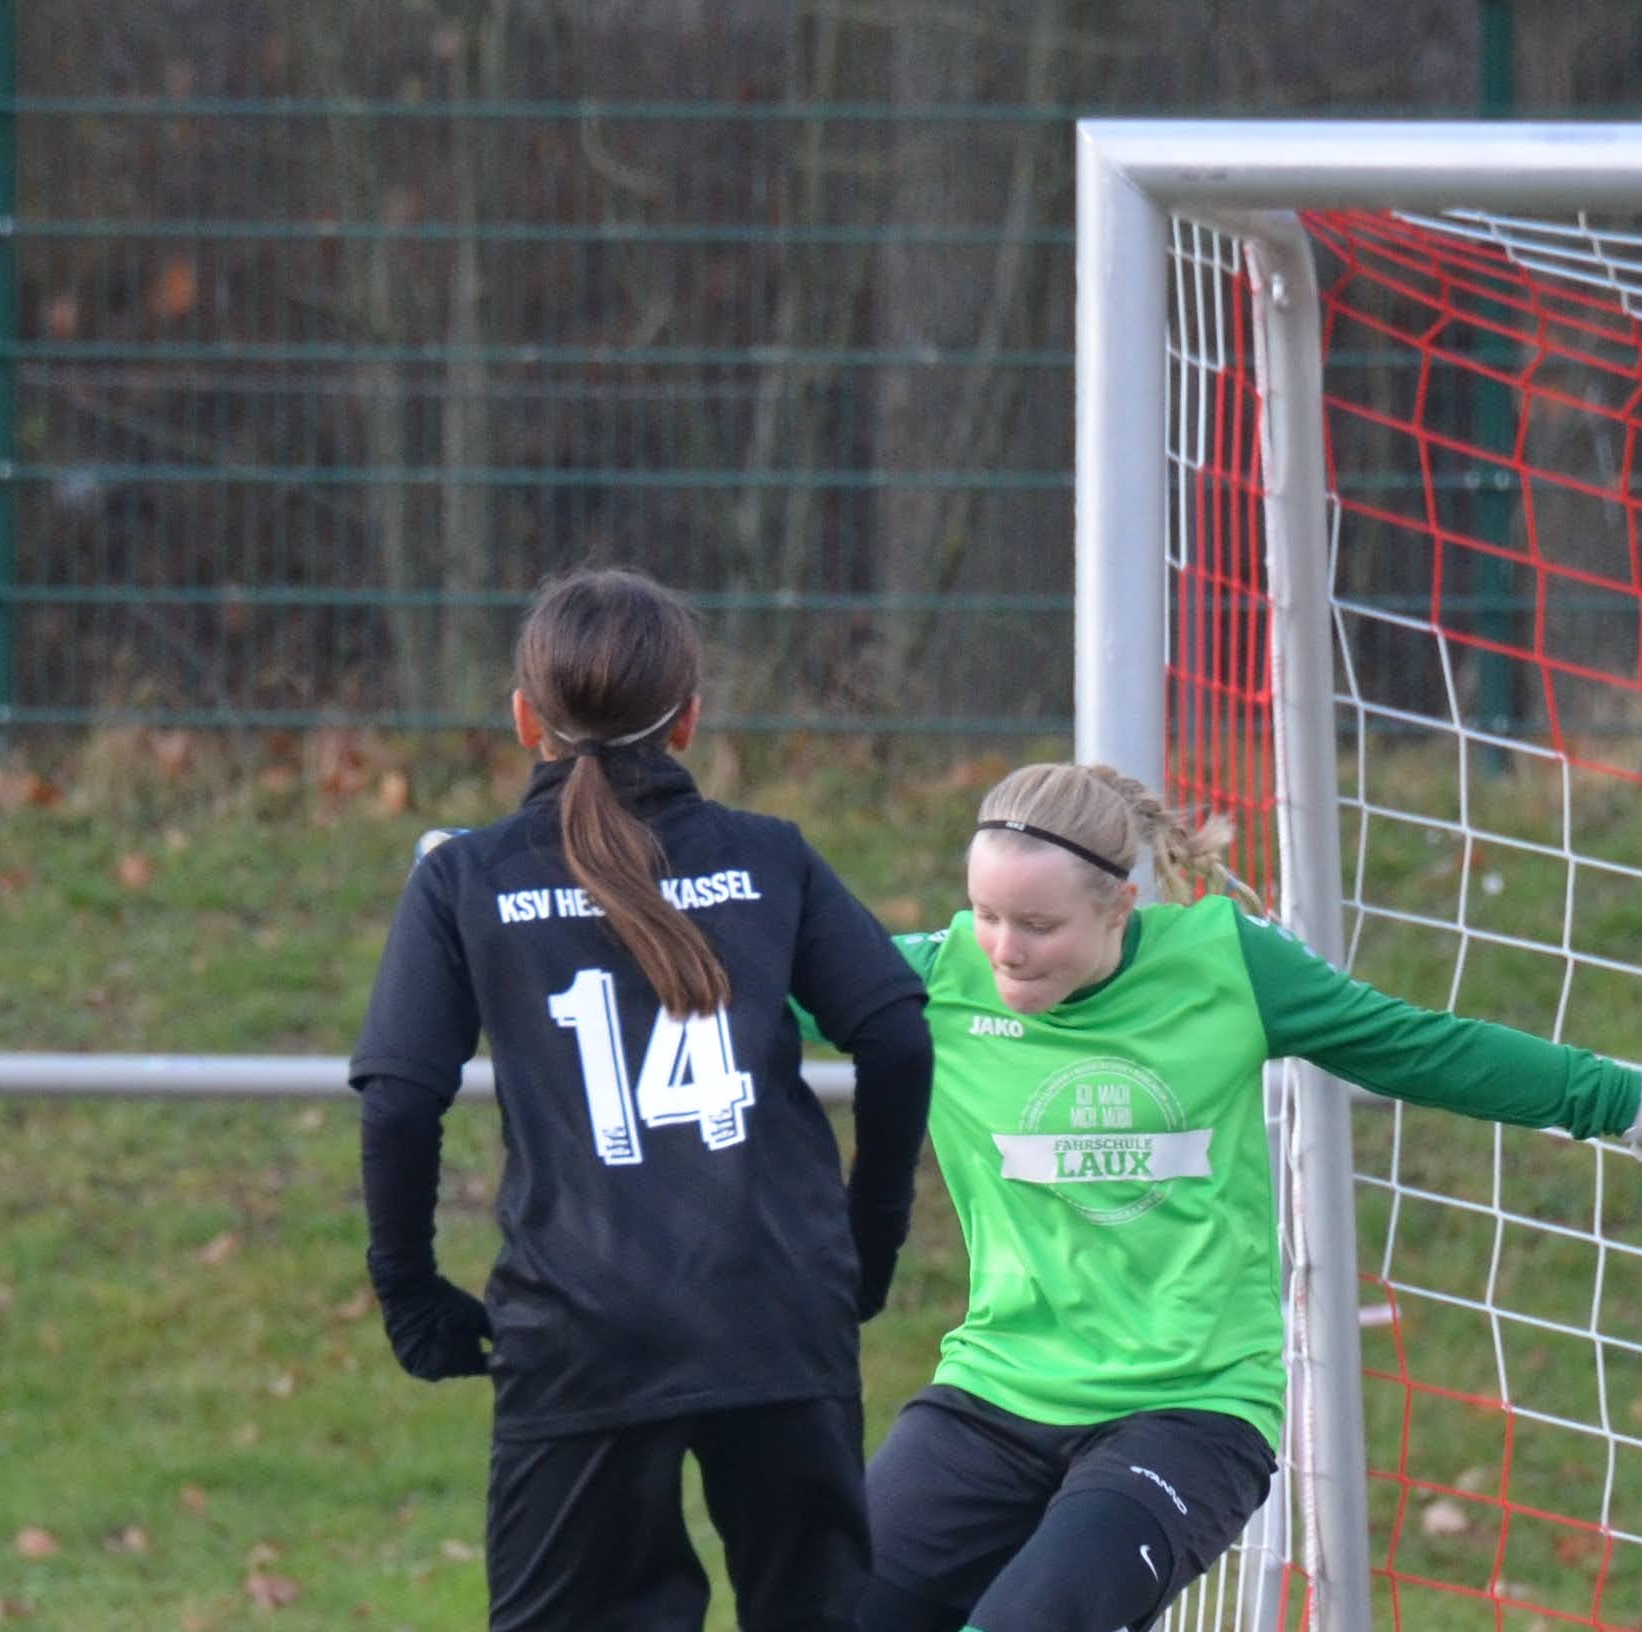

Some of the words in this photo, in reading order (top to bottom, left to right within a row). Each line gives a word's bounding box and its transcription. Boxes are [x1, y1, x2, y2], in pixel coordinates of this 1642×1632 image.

[497, 889, 550, 923] KSV
[660, 870, 762, 911] KASSEL
[968, 1015, 1024, 1038] JAKO
[548, 968, 755, 1165] 14
[1054, 1138, 1154, 1152] FAHRSCHULE
[1054, 1151, 1153, 1179] LAUX
